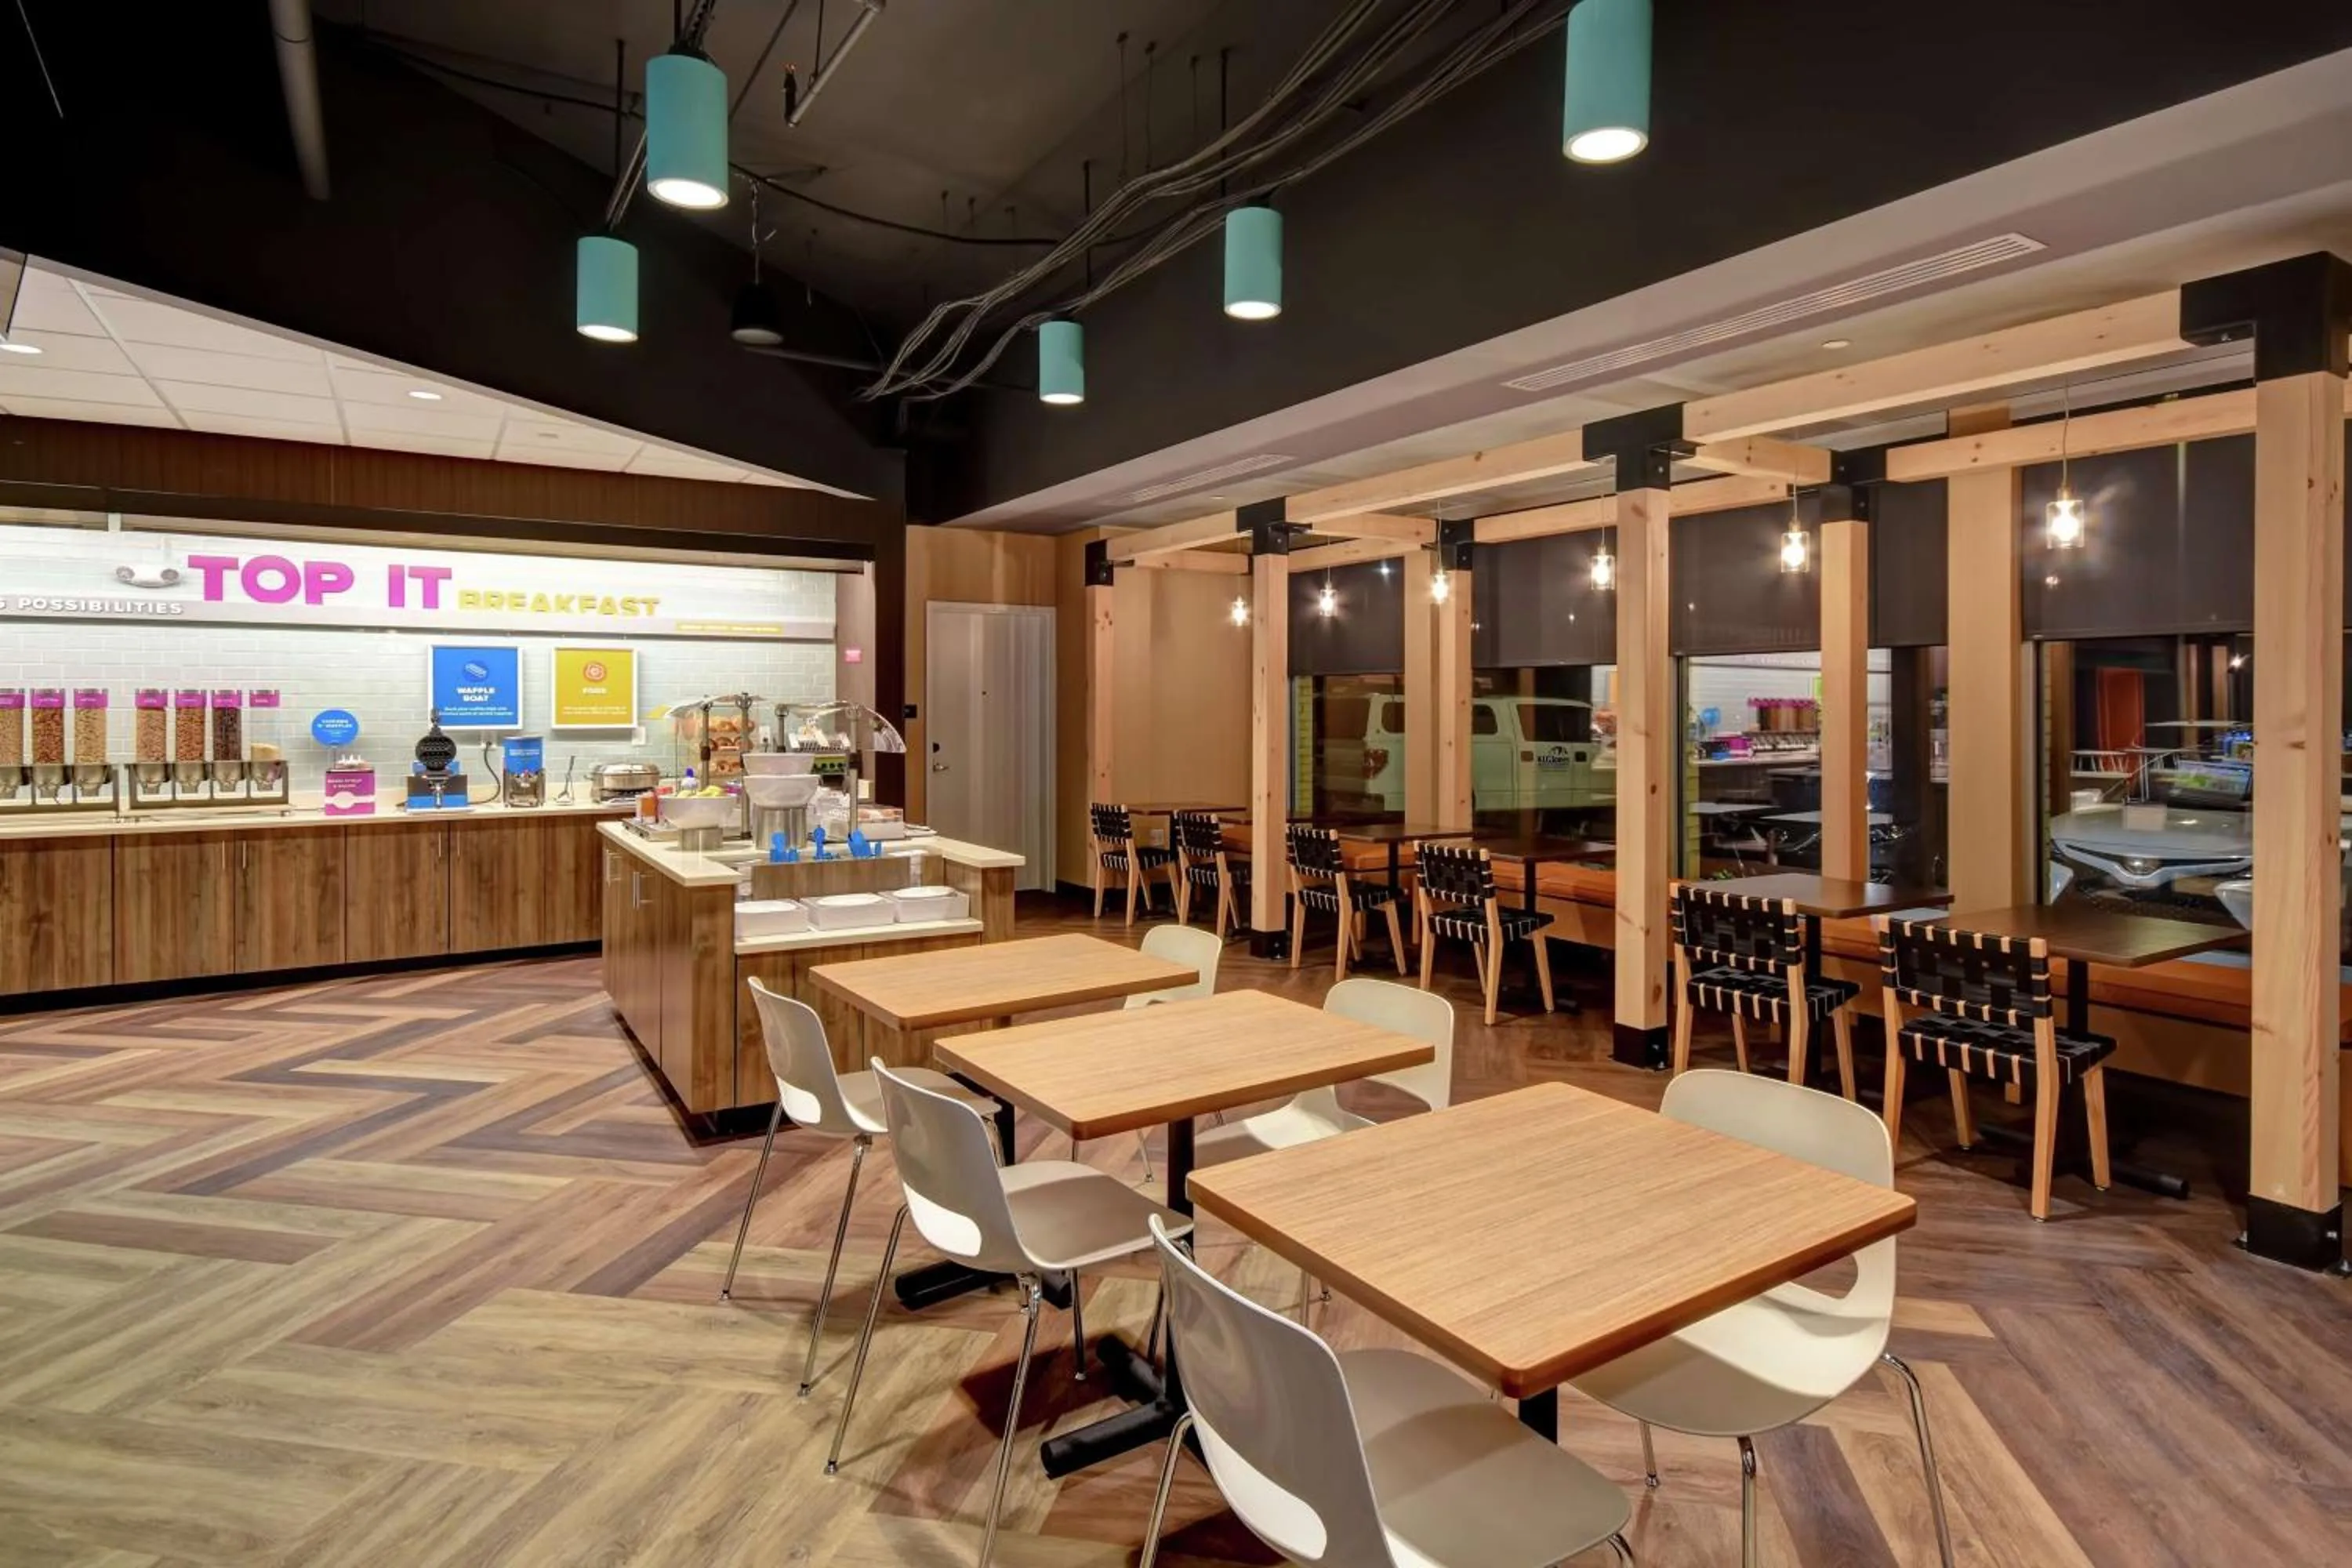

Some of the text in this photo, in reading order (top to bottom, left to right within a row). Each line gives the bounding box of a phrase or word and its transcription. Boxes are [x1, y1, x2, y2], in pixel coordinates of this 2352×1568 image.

[188, 555, 452, 609] TOP IT
[17, 597, 183, 615] POSSIBILITIES
[458, 590, 662, 617] BREAKFAST
